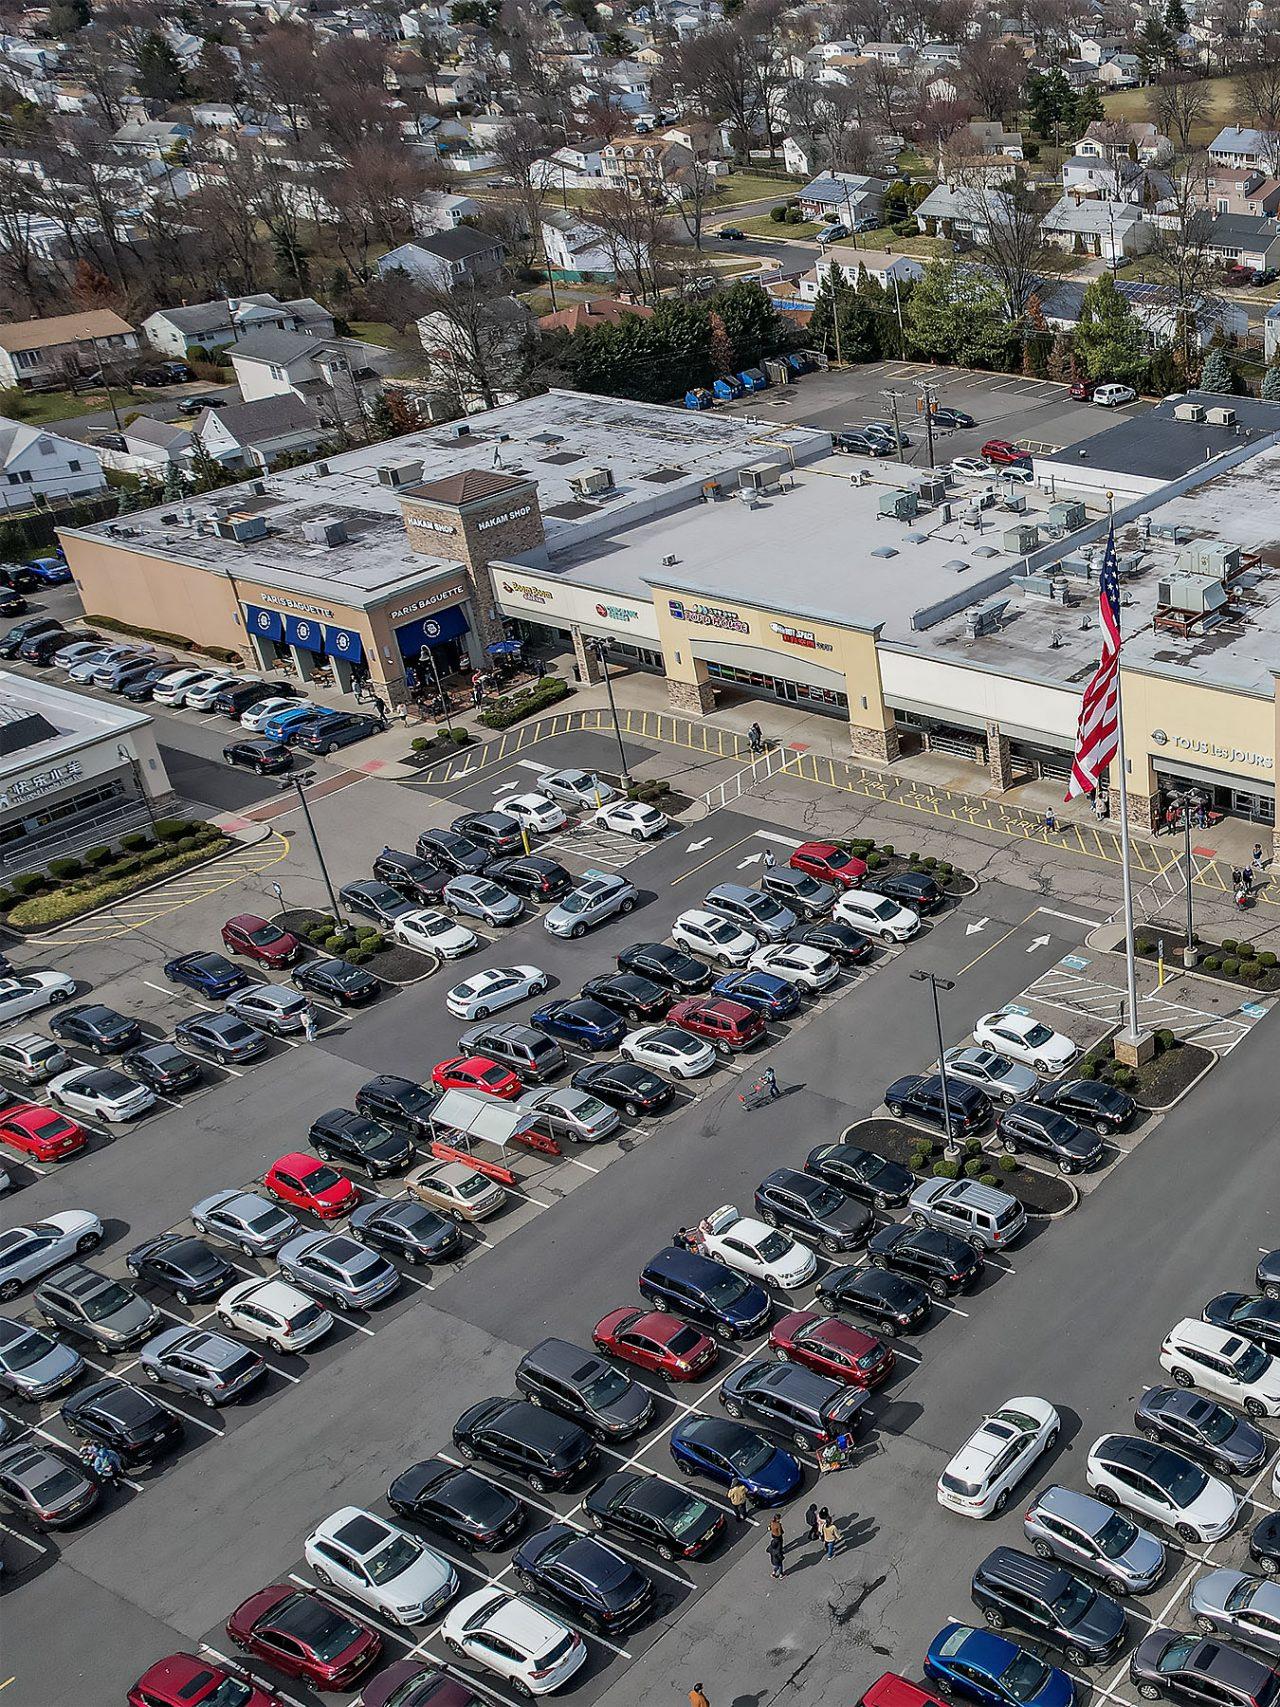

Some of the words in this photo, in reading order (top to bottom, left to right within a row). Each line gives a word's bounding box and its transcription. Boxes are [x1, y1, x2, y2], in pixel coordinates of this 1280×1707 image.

[408, 517, 433, 530] HAKAM
[433, 522, 455, 534] SHOP
[479, 513, 508, 531] HAKAM
[509, 506, 532, 521] SHOP
[261, 593, 287, 607] PARIS
[286, 599, 333, 618] BAGUETTE
[391, 603, 418, 619] PARIS
[418, 585, 464, 609] BAGUETTE
[712, 614, 750, 635] HOUSE
[1172, 735, 1209, 754] TOUS
[1210, 743, 1229, 759] les
[1229, 748, 1274, 769] JOURS
[857, 777, 890, 792] FIRE
[904, 790, 944, 806] ZONE
[959, 804, 982, 816] NO
[999, 814, 1057, 835] PARKIN
